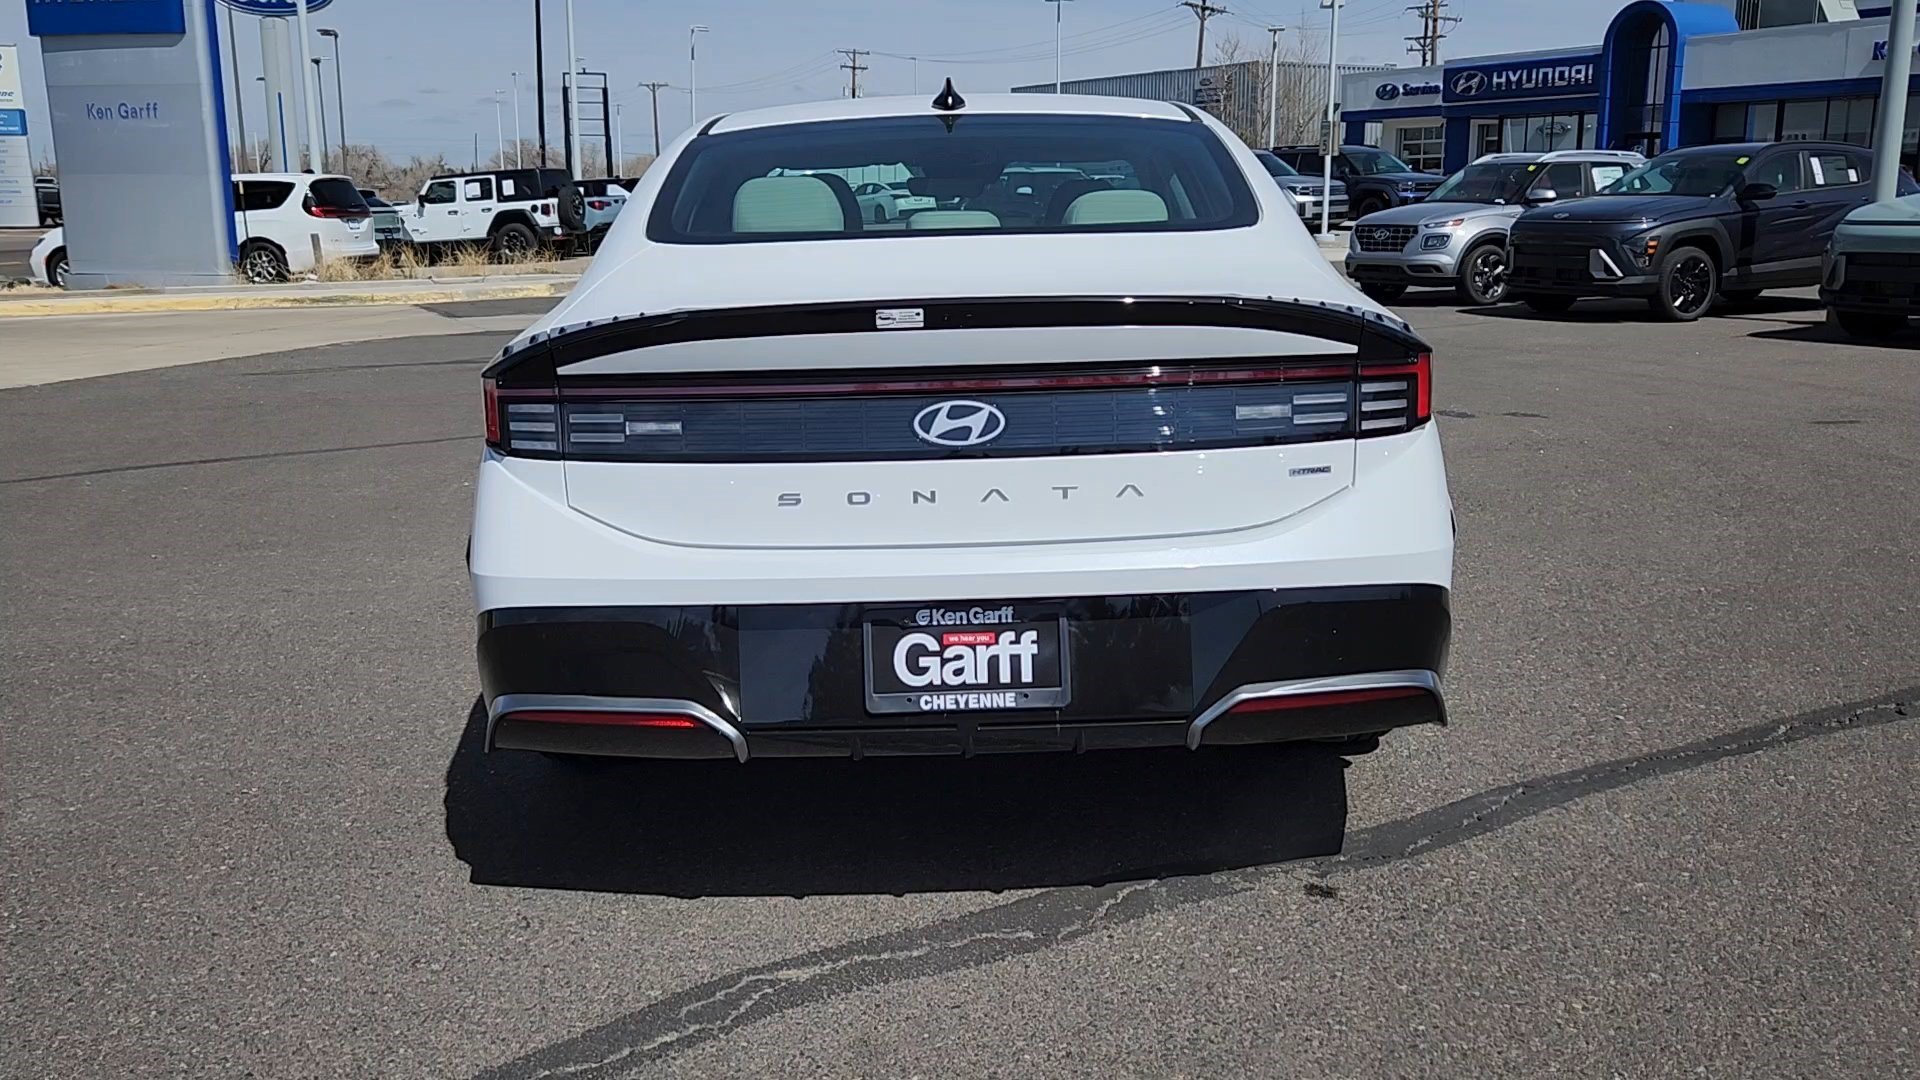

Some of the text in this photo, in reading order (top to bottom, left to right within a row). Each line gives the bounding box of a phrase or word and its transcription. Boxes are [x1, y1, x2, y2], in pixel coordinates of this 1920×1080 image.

[1492, 64, 1594, 91] HYUNDAI
[86, 102, 158, 120] Ken Garff
[777, 484, 1144, 507] SONATA
[932, 606, 1014, 625] Ken Garff
[976, 635, 990, 643] you
[893, 630, 1038, 687] Garff
[920, 692, 1017, 710] CHEYENNE
